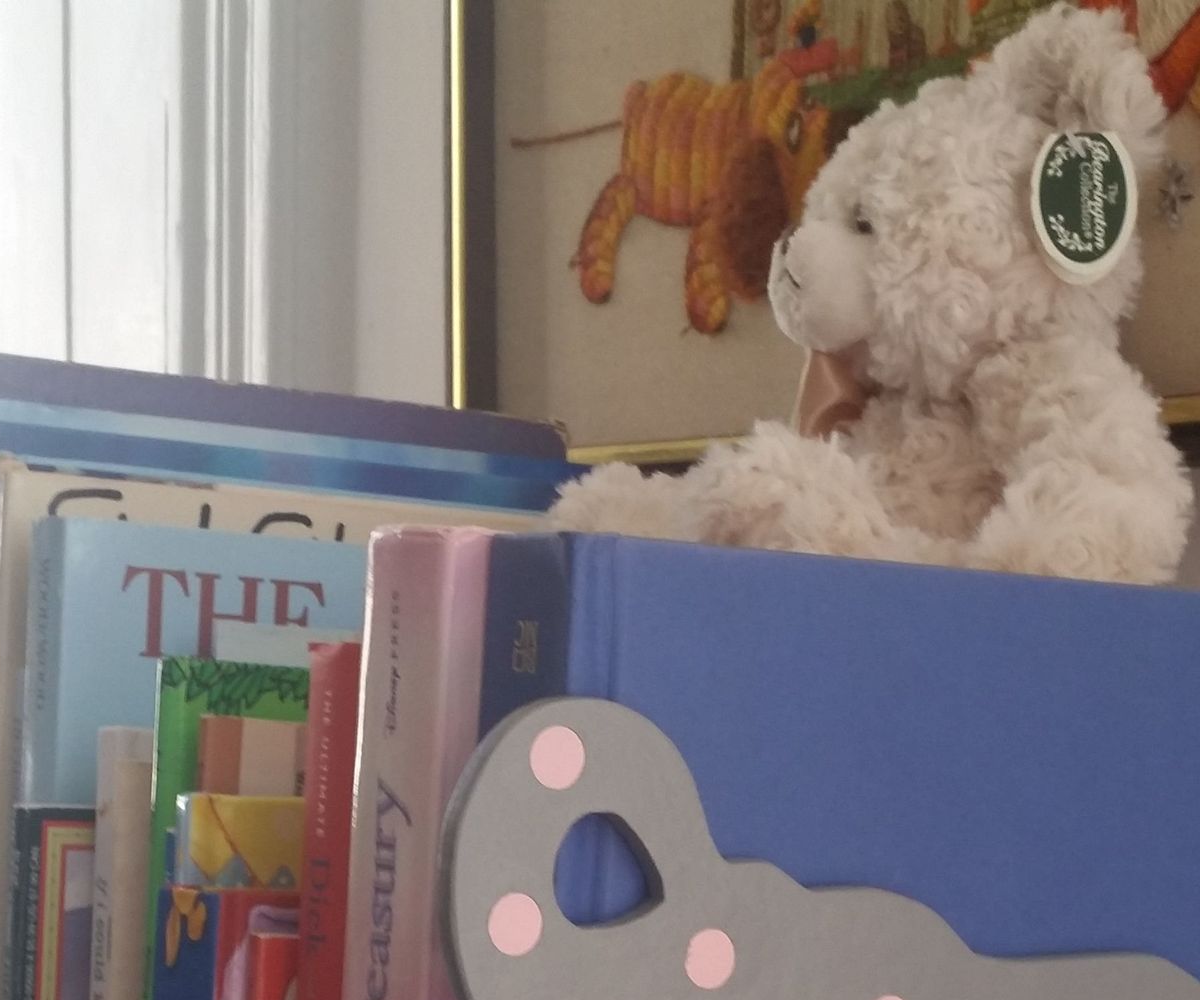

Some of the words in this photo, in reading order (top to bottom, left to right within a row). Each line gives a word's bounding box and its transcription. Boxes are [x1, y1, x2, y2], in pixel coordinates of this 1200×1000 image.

[1088, 142, 1110, 250] Bearington
[122, 564, 325, 660] THE
[391, 590, 400, 659] PRESS
[323, 690, 333, 727] THE
[314, 736, 332, 840] ULTIMATE
[306, 858, 330, 957] Dick
